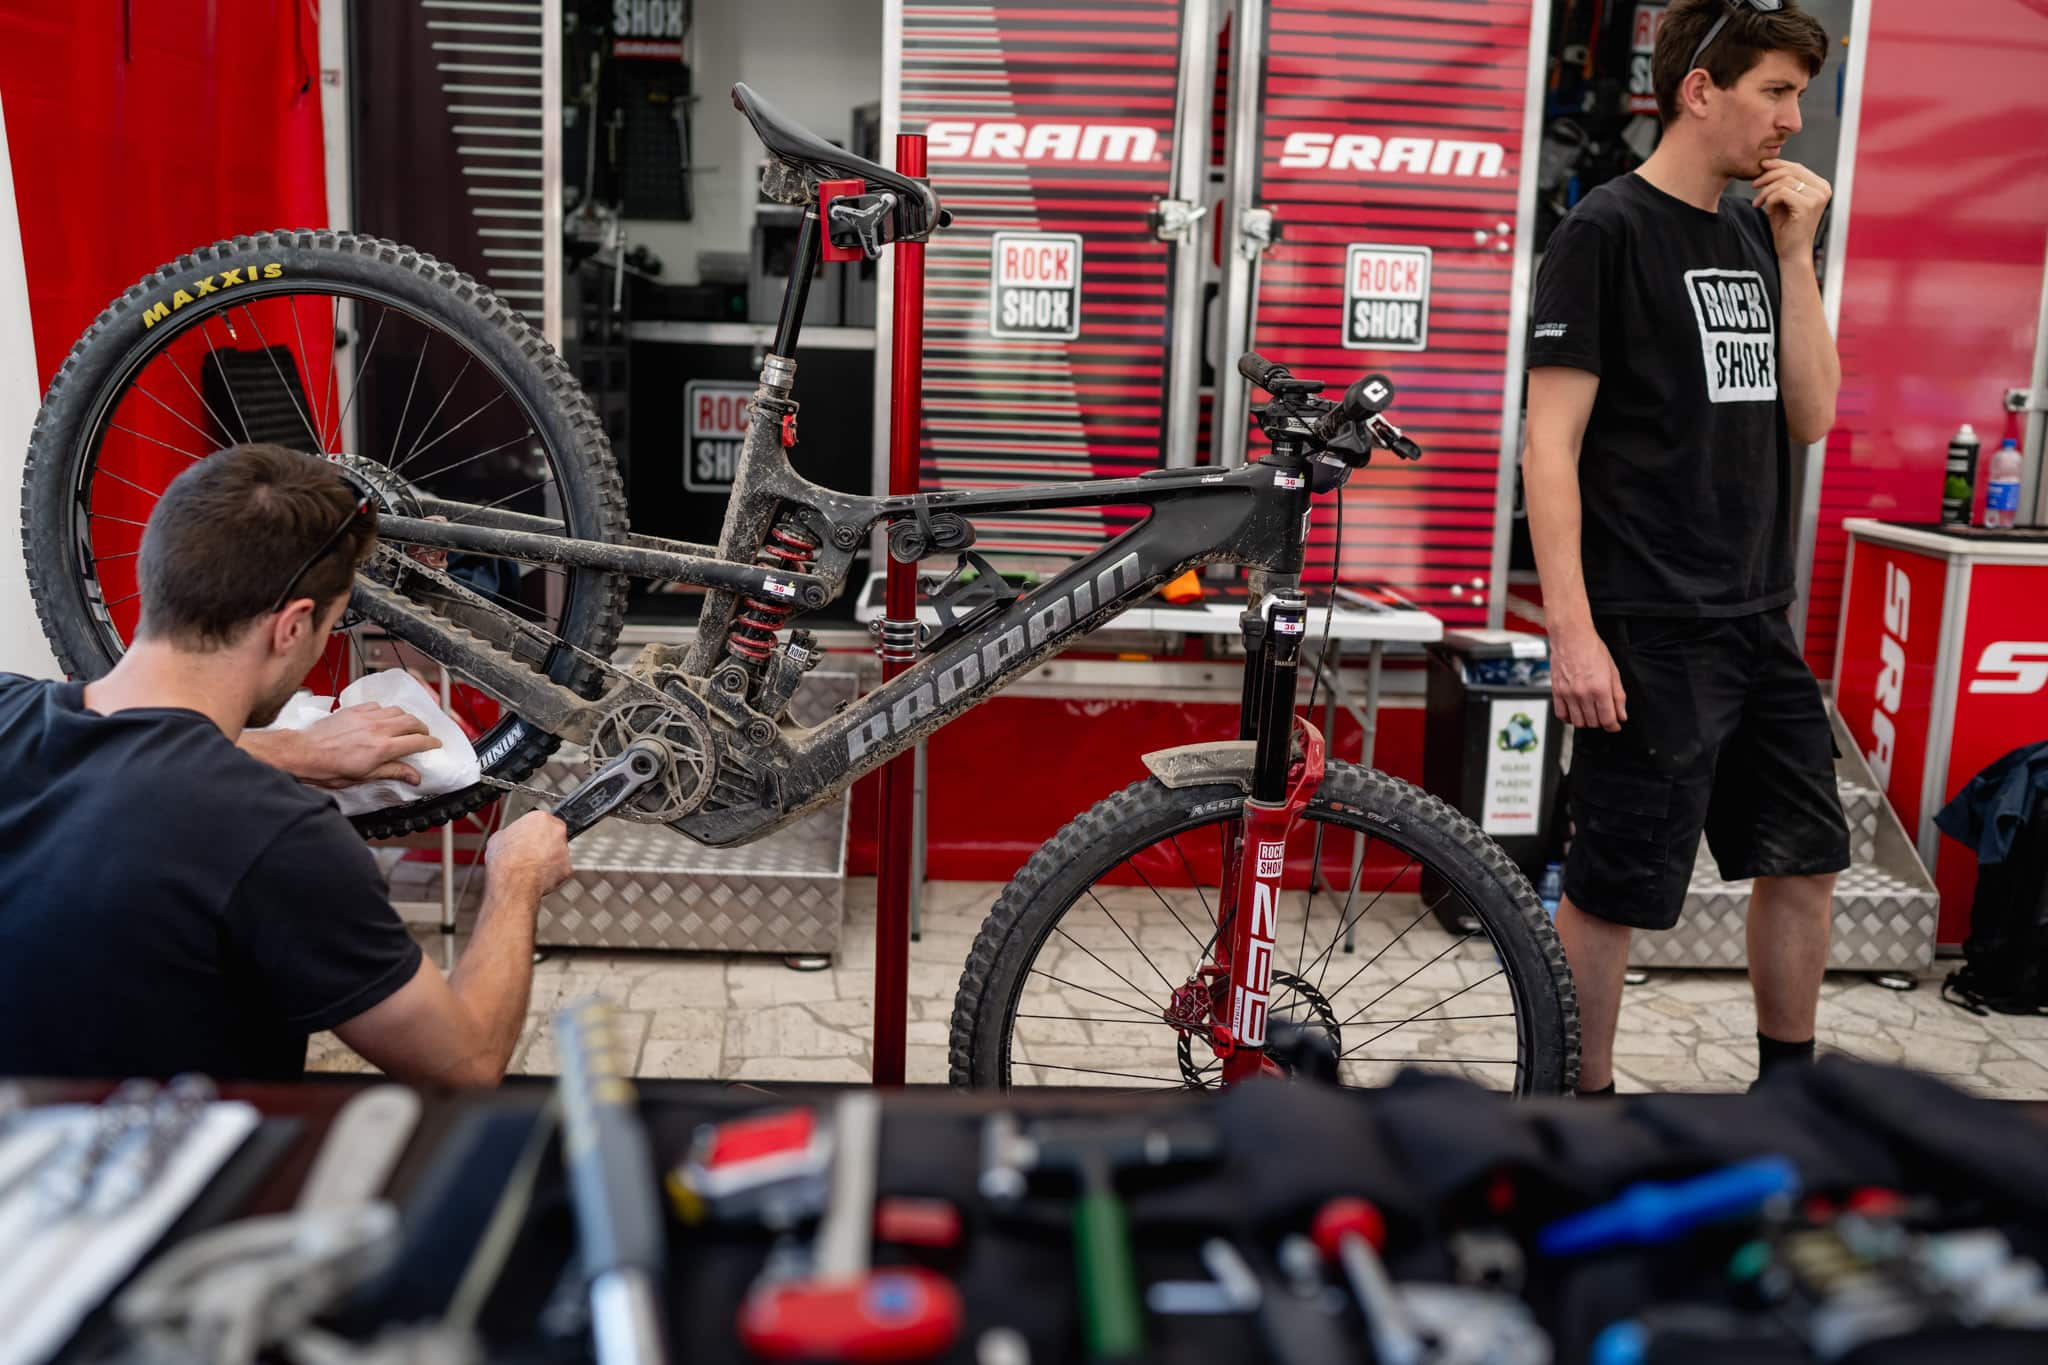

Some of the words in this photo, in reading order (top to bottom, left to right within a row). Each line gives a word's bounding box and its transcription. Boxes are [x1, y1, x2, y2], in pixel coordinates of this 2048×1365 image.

[614, 0, 682, 36] SHOX
[926, 122, 1158, 161] SRAM
[1280, 132, 1504, 177] SRAM
[1006, 247, 1069, 281] ROCK
[1359, 258, 1418, 293] ROCK
[142, 263, 283, 328] MAXXIS
[1003, 289, 1070, 328] SHOX
[1698, 280, 1767, 329] ROCK
[1354, 301, 1418, 339] SHOX
[1716, 340, 1771, 389] SHOX
[698, 395, 751, 432] ROC
[847, 551, 1140, 762] PROPAIN
[1868, 561, 1911, 792] SRA
[1262, 845, 1284, 859] ROCK
[1242, 881, 1280, 1047] ZEB
[1233, 997, 1241, 1028] ULTIMATE
